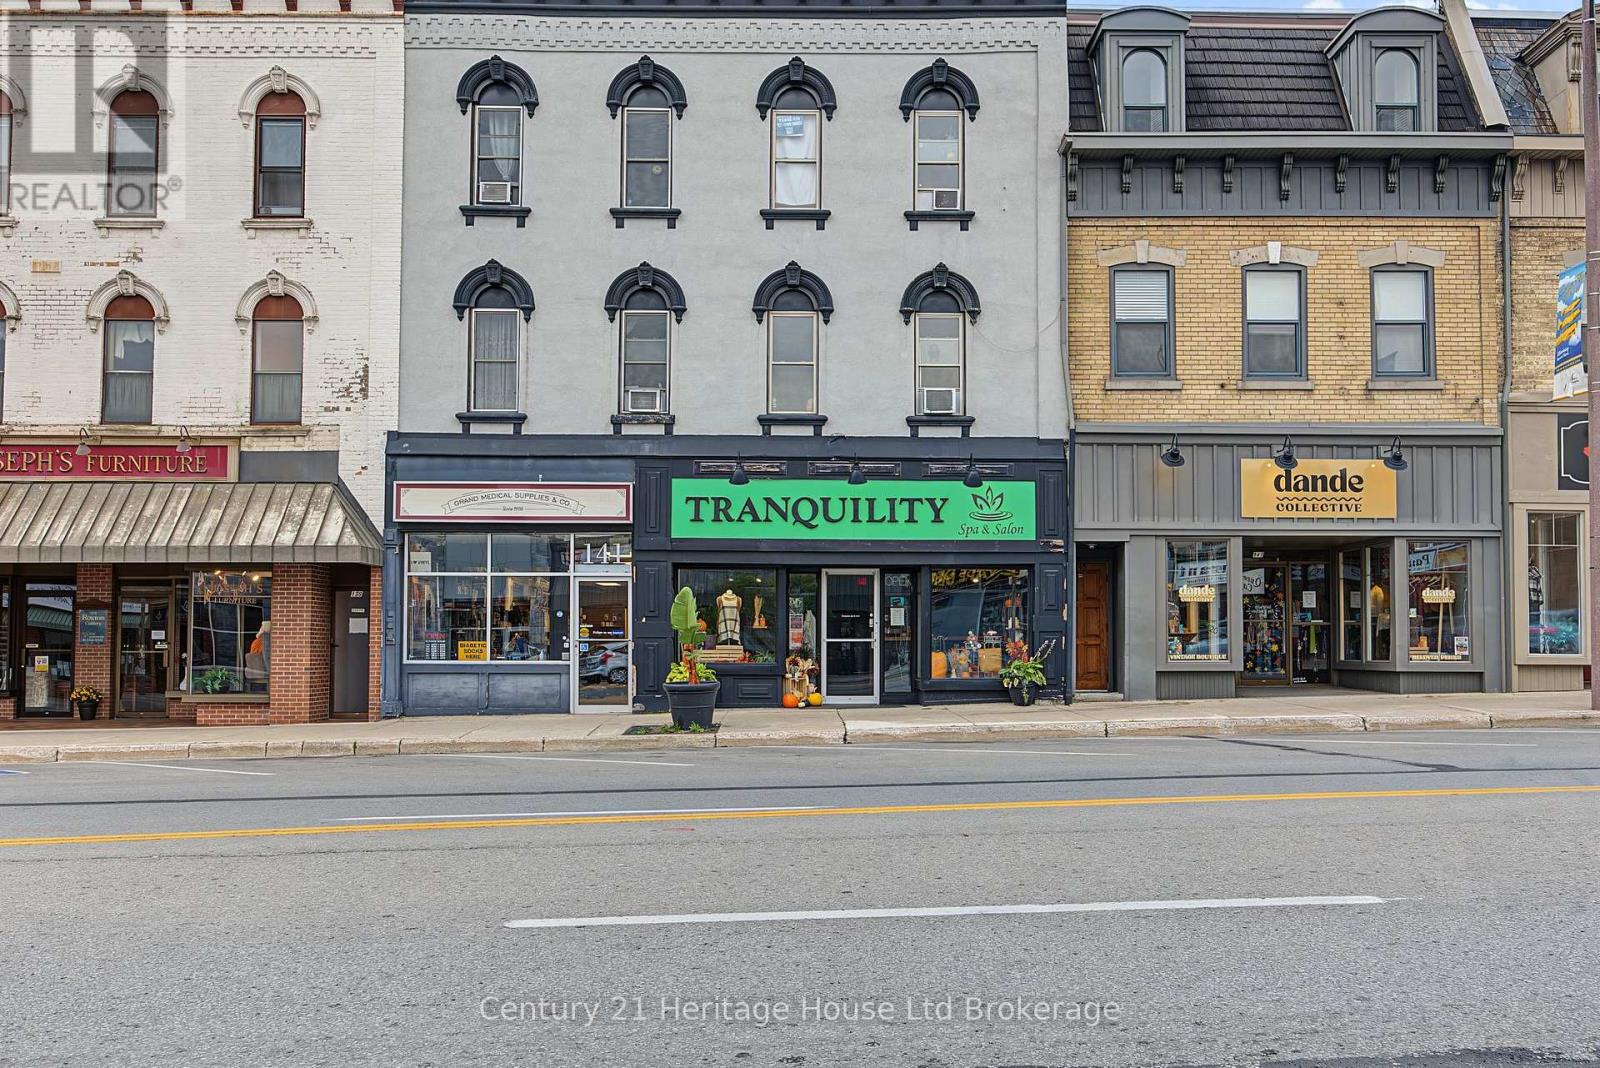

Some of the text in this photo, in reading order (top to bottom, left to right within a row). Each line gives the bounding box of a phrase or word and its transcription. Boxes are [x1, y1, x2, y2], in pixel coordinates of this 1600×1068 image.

[86, 455, 208, 474] FURNITURE
[1273, 467, 1364, 493] dande
[453, 495, 479, 507] GRAND
[481, 492, 513, 501] MEDICAL
[514, 492, 550, 502] SUPPLIES
[684, 496, 949, 529] TRANQUILITY
[1275, 503, 1362, 513] COLLECTIVE
[958, 522, 1024, 538] Spa & Salon
[583, 543, 626, 564] 141
[1178, 584, 1217, 595] dande
[1422, 587, 1456, 597] dande
